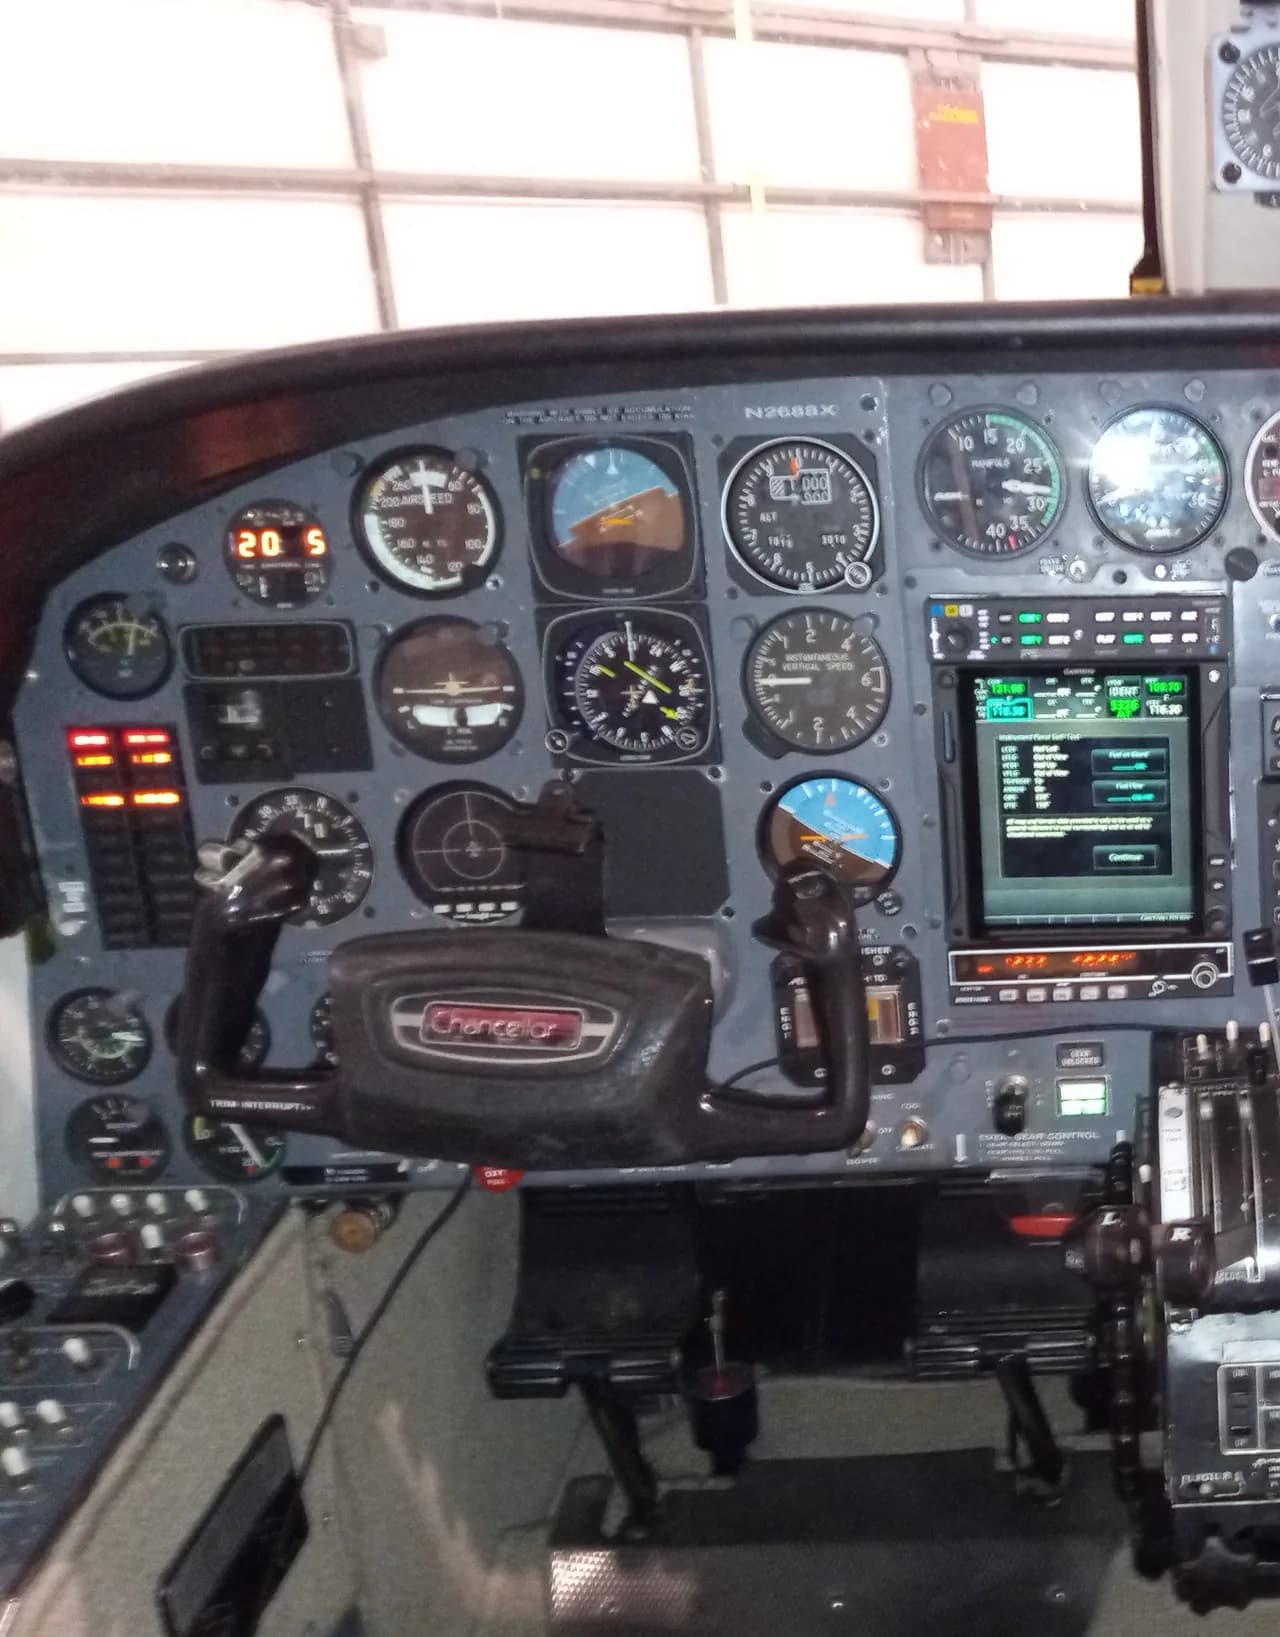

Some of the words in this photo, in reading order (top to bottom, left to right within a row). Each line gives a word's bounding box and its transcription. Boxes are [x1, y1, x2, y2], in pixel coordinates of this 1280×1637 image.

[958, 435, 974, 451] 10
[983, 428, 998, 445] 15
[1006, 437, 1026, 453] 20
[1023, 457, 1043, 474] 25
[401, 494, 454, 506] AIRSEED
[1026, 496, 1046, 512] 30
[1009, 515, 1029, 531] 35
[985, 523, 1006, 538] 40
[805, 629, 816, 643] 2
[841, 638, 851, 651] 4
[785, 652, 850, 663] INSTANTANEOUS
[783, 662, 820, 671] VERTICAL
[825, 661, 854, 671] SPEED
[861, 673, 873, 687] 6
[845, 706, 856, 720] 4
[813, 717, 824, 730] 2
[861, 946, 893, 956] ISHER
[1070, 1049, 1091, 1058] GEAR
[1061, 1056, 1102, 1066] UNLOCKED
[210, 1099, 237, 1108] TRIM
[1046, 1131, 1100, 1140] CONTROL
[1170, 1227, 1192, 1242] R
